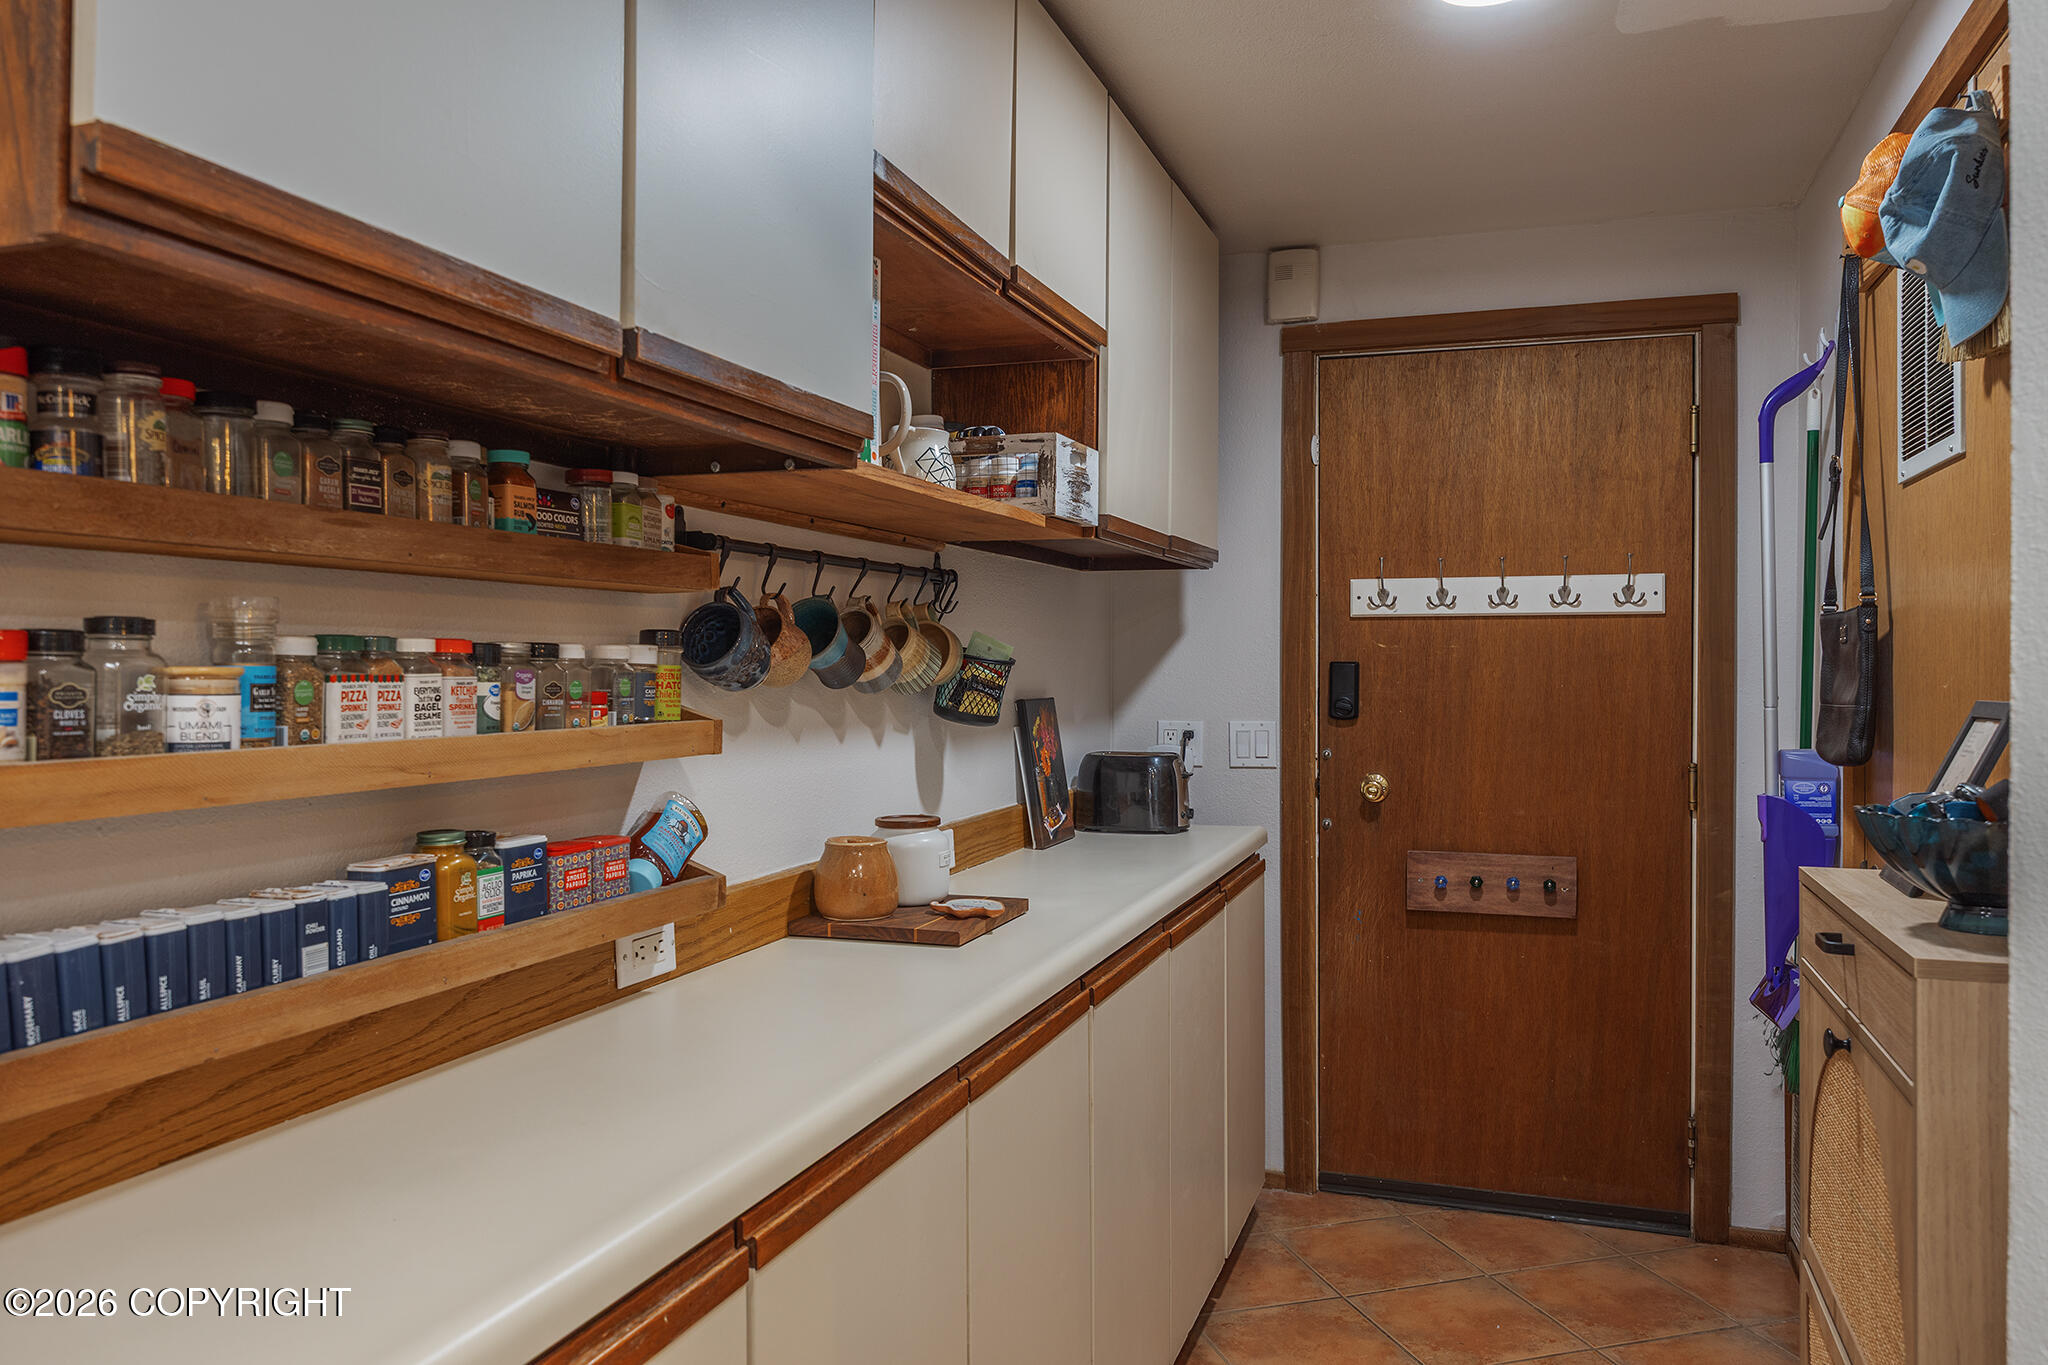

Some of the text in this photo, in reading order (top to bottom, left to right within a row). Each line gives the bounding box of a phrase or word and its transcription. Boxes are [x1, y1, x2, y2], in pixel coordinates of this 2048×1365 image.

[513, 501, 535, 510] SALMON
[553, 514, 579, 525] COLORS
[341, 690, 368, 703] PIZZA
[377, 689, 402, 702] PIZZA
[450, 685, 477, 697] KETCHUP
[126, 691, 161, 703] Simply
[123, 701, 163, 714] Organic
[340, 703, 368, 713] SPRINKLE
[377, 703, 402, 712] SPRINKLE
[414, 702, 441, 712] BAGEL
[448, 703, 477, 711] SPRINKLE
[414, 711, 441, 720] SESAME
[178, 721, 223, 731] UMAMI
[180, 731, 221, 742] BLEND
[606, 863, 625, 873] SMOKED
[512, 869, 537, 881] PAPRIKA
[566, 872, 587, 882] SMOKED
[605, 870, 625, 880] PAPRIKA
[482, 880, 503, 892] AGLIO
[566, 879, 587, 889] PAPRIKA
[455, 884, 475, 897] Simply
[484, 888, 501, 899] OLIO
[391, 891, 430, 907] CINNAMON
[453, 892, 478, 903] Organic
[235, 955, 243, 993] CARAWAY
[159, 975, 169, 1011] ALLSPICE
[199, 978, 207, 1001] BASIL
[115, 985, 126, 1022] ALLSPICE
[23, 996, 36, 1046] ROSEMARY
[72, 1009, 83, 1034] SAGE
